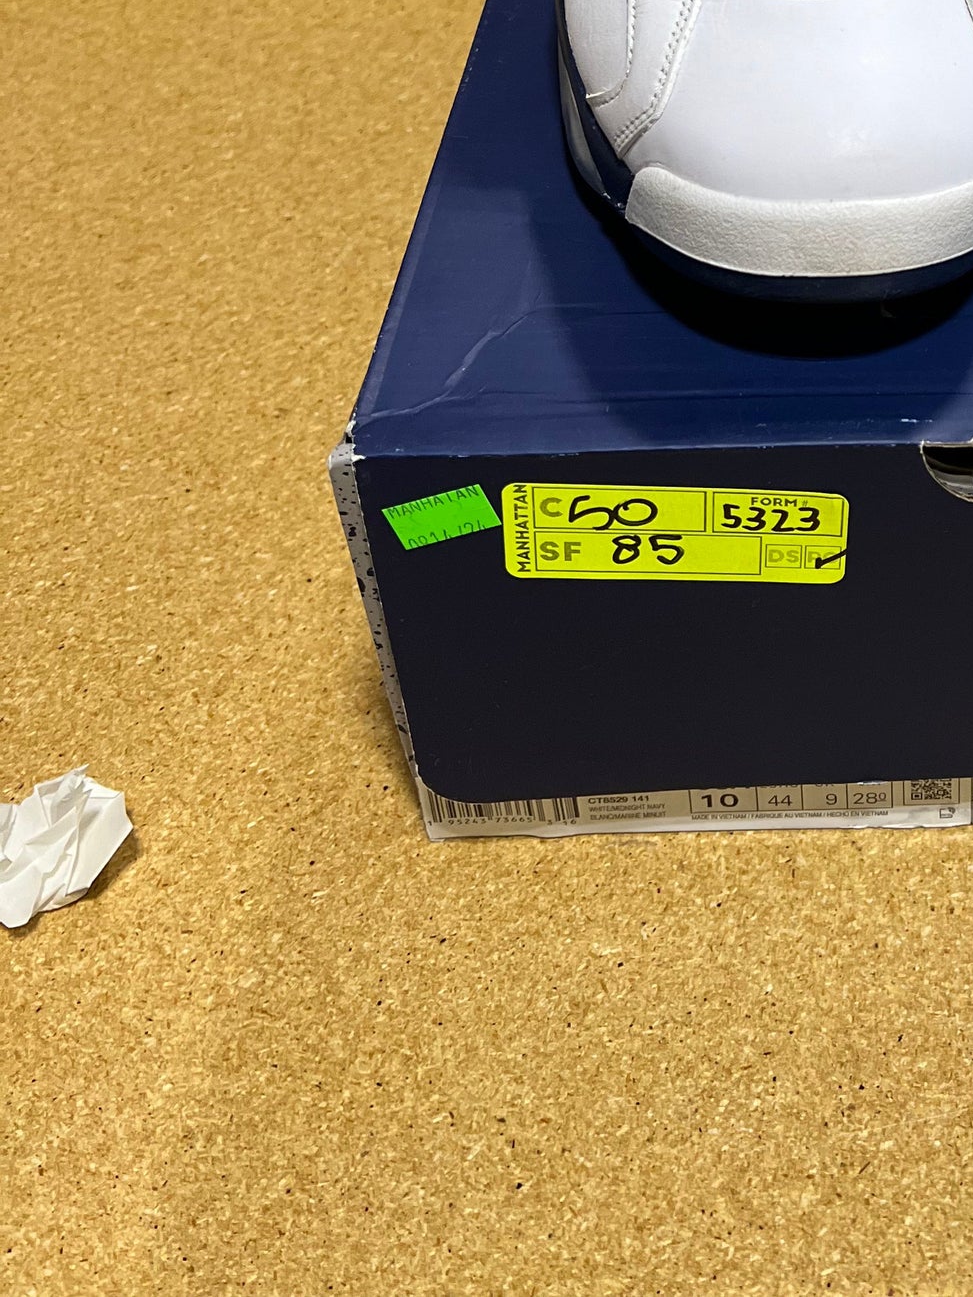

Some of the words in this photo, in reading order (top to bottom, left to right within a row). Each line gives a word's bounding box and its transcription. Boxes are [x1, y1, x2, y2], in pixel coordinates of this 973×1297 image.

[539, 496, 564, 518] C
[750, 496, 798, 507] FORM
[568, 494, 659, 531] 50
[720, 503, 821, 533] 5323
[512, 484, 532, 573] MANHATTAN
[539, 540, 582, 562] SF
[612, 534, 685, 565] 85
[768, 548, 800, 564] DS
[587, 795, 629, 805] CT8529
[631, 794, 650, 803] 141
[646, 802, 666, 810] NAVY
[701, 793, 739, 808] 10
[767, 794, 793, 807] 44
[825, 792, 838, 806] 9
[691, 813, 710, 821] MADE
[718, 812, 747, 820] VIETNAM
[751, 811, 784, 820] FABRIQUE
[784, 811, 793, 819] AU
[793, 810, 823, 819] VIETNAM
[826, 810, 850, 818] HECHO
[850, 810, 860, 818] EN
[860, 809, 889, 817] VIETNAM
